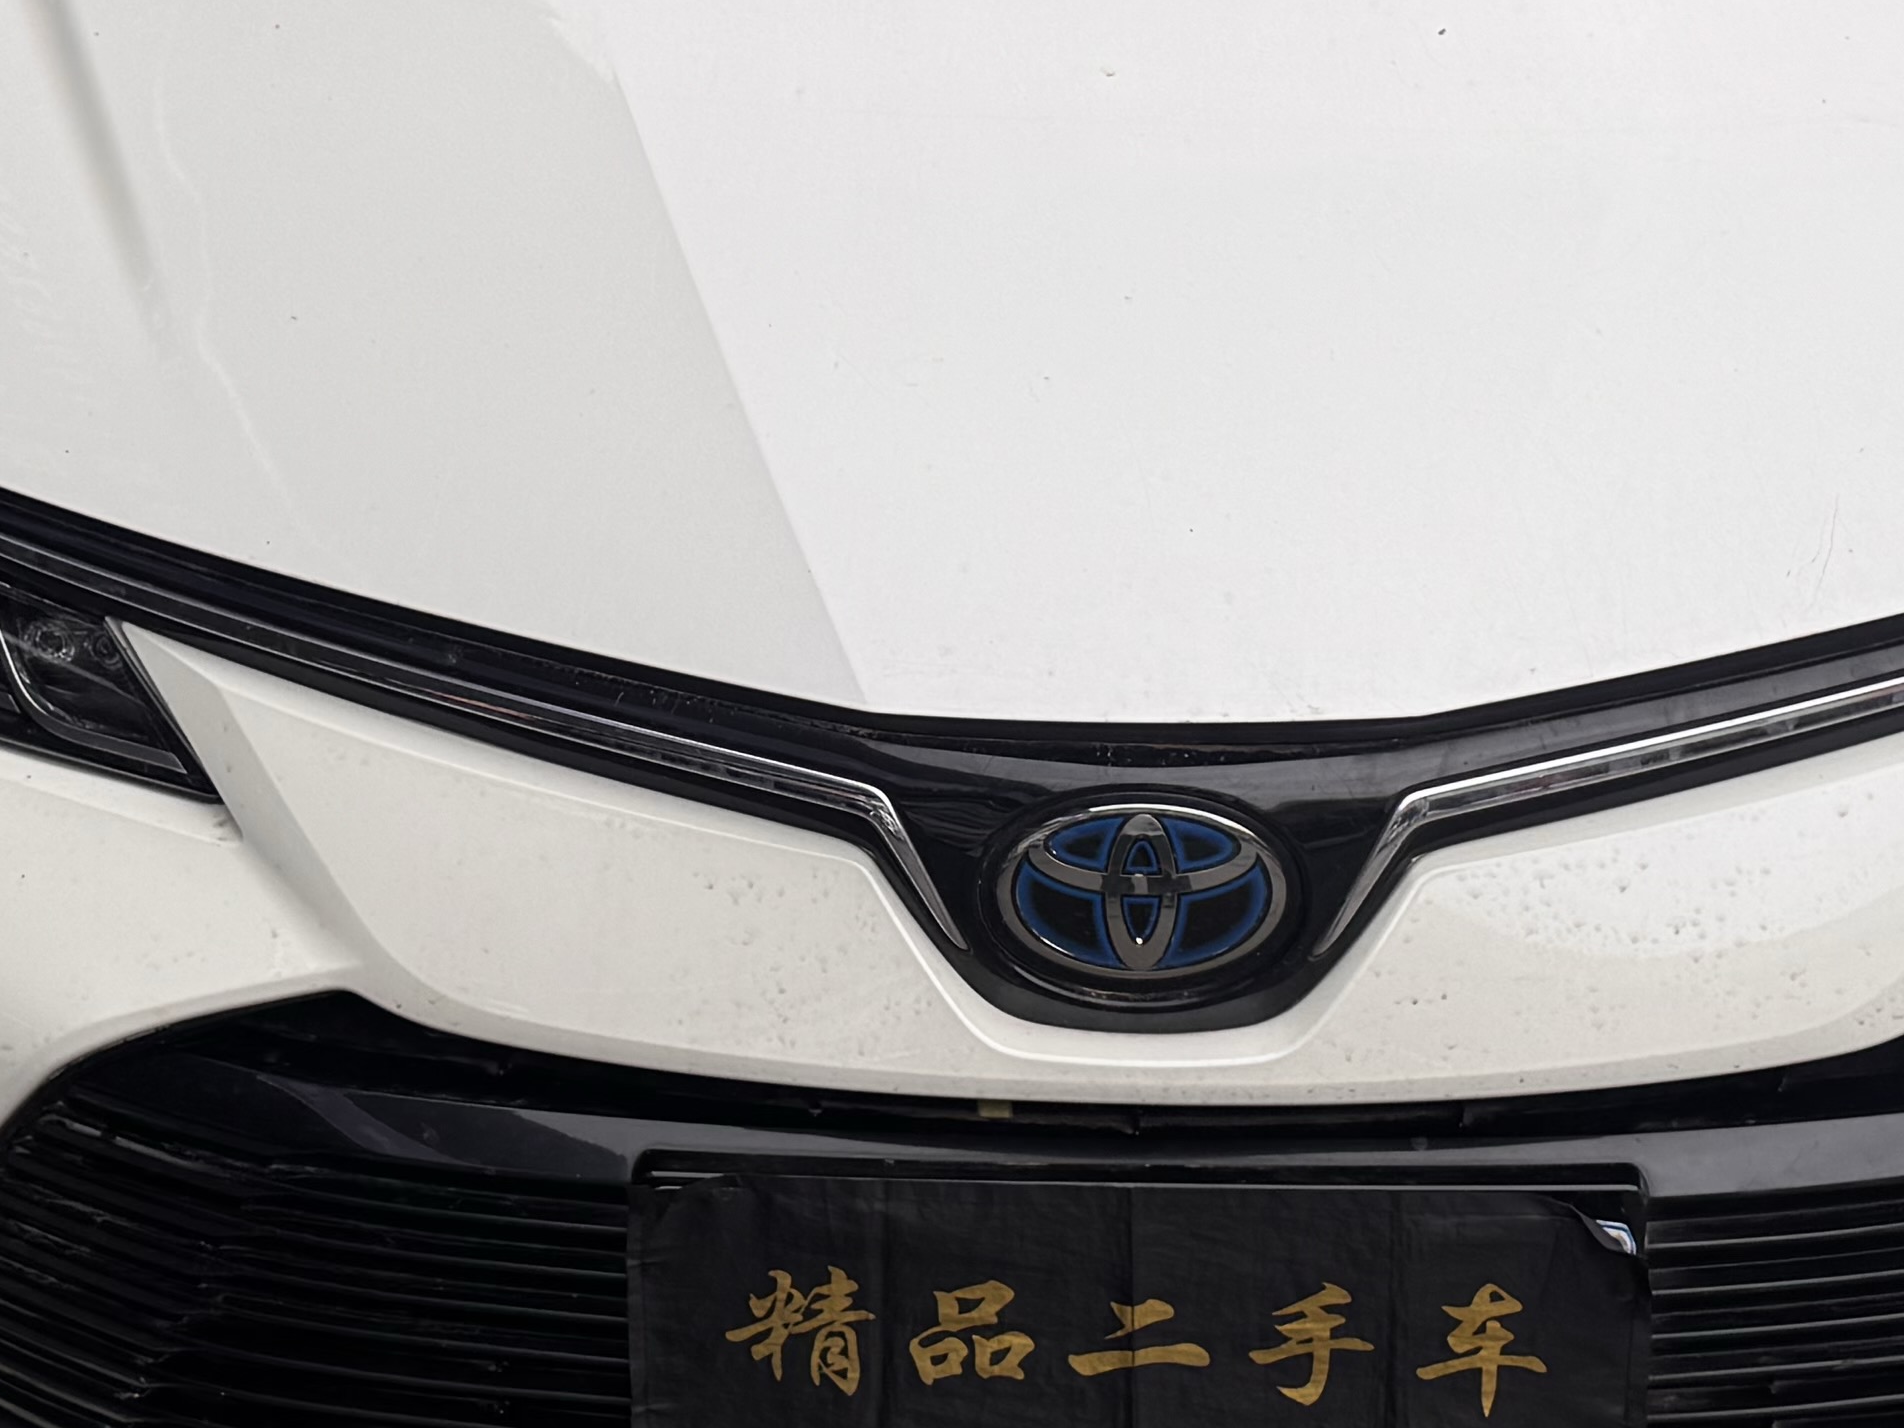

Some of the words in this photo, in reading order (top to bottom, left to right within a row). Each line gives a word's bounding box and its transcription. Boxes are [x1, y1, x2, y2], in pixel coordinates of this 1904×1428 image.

[724, 1265, 1548, 1418] 精品二手车
